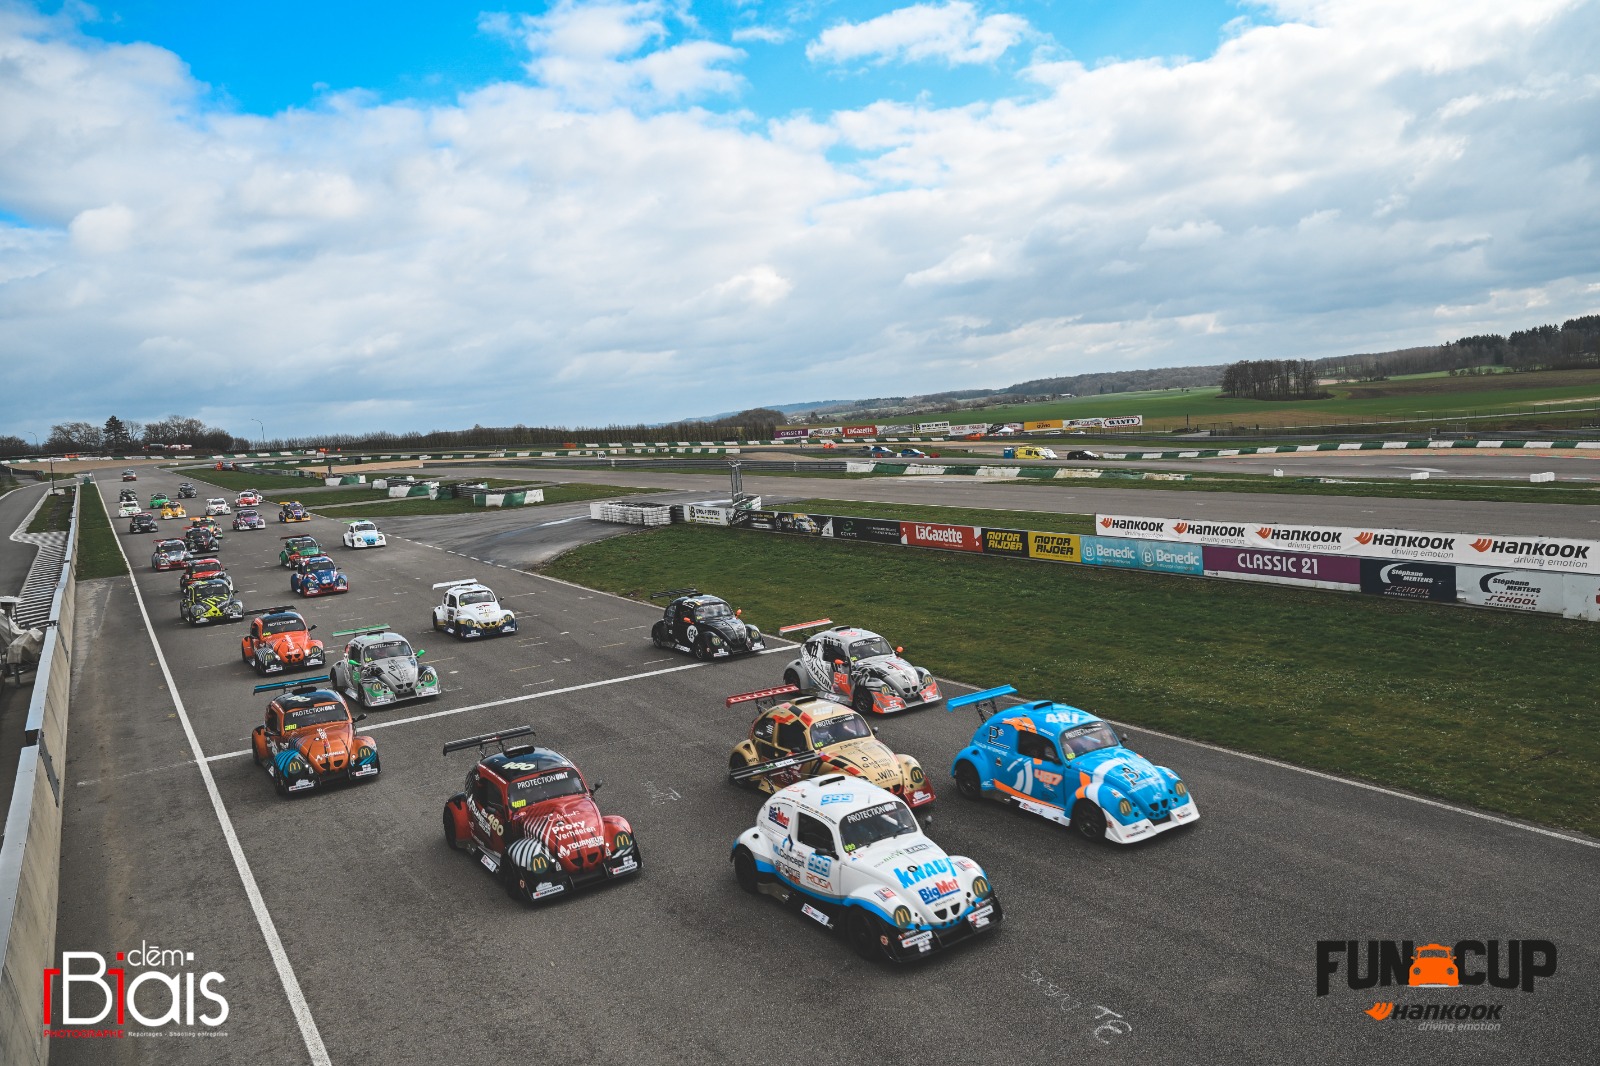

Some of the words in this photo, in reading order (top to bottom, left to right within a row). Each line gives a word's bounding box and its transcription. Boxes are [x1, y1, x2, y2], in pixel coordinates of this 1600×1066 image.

[986, 531, 1020, 544] MOTOR
[1033, 535, 1071, 549] MOTOR
[988, 540, 1023, 551] RIJDER
[1035, 545, 1075, 557] RIJDER
[1096, 544, 1136, 560] Benedic
[1156, 549, 1200, 566] Benedic
[1391, 547, 1418, 557] driving
[1420, 549, 1454, 559] emotion
[1237, 552, 1297, 573] CLASSIC
[1301, 557, 1318, 576] 21
[1513, 556, 1545, 567] driving
[1547, 559, 1588, 569] emotion
[1485, 595, 1538, 606] SCHOOL
[820, 793, 854, 806] 999
[488, 813, 504, 836] 480
[551, 820, 586, 834] Proxy
[808, 852, 832, 878] 999
[918, 878, 960, 901] BigMat
